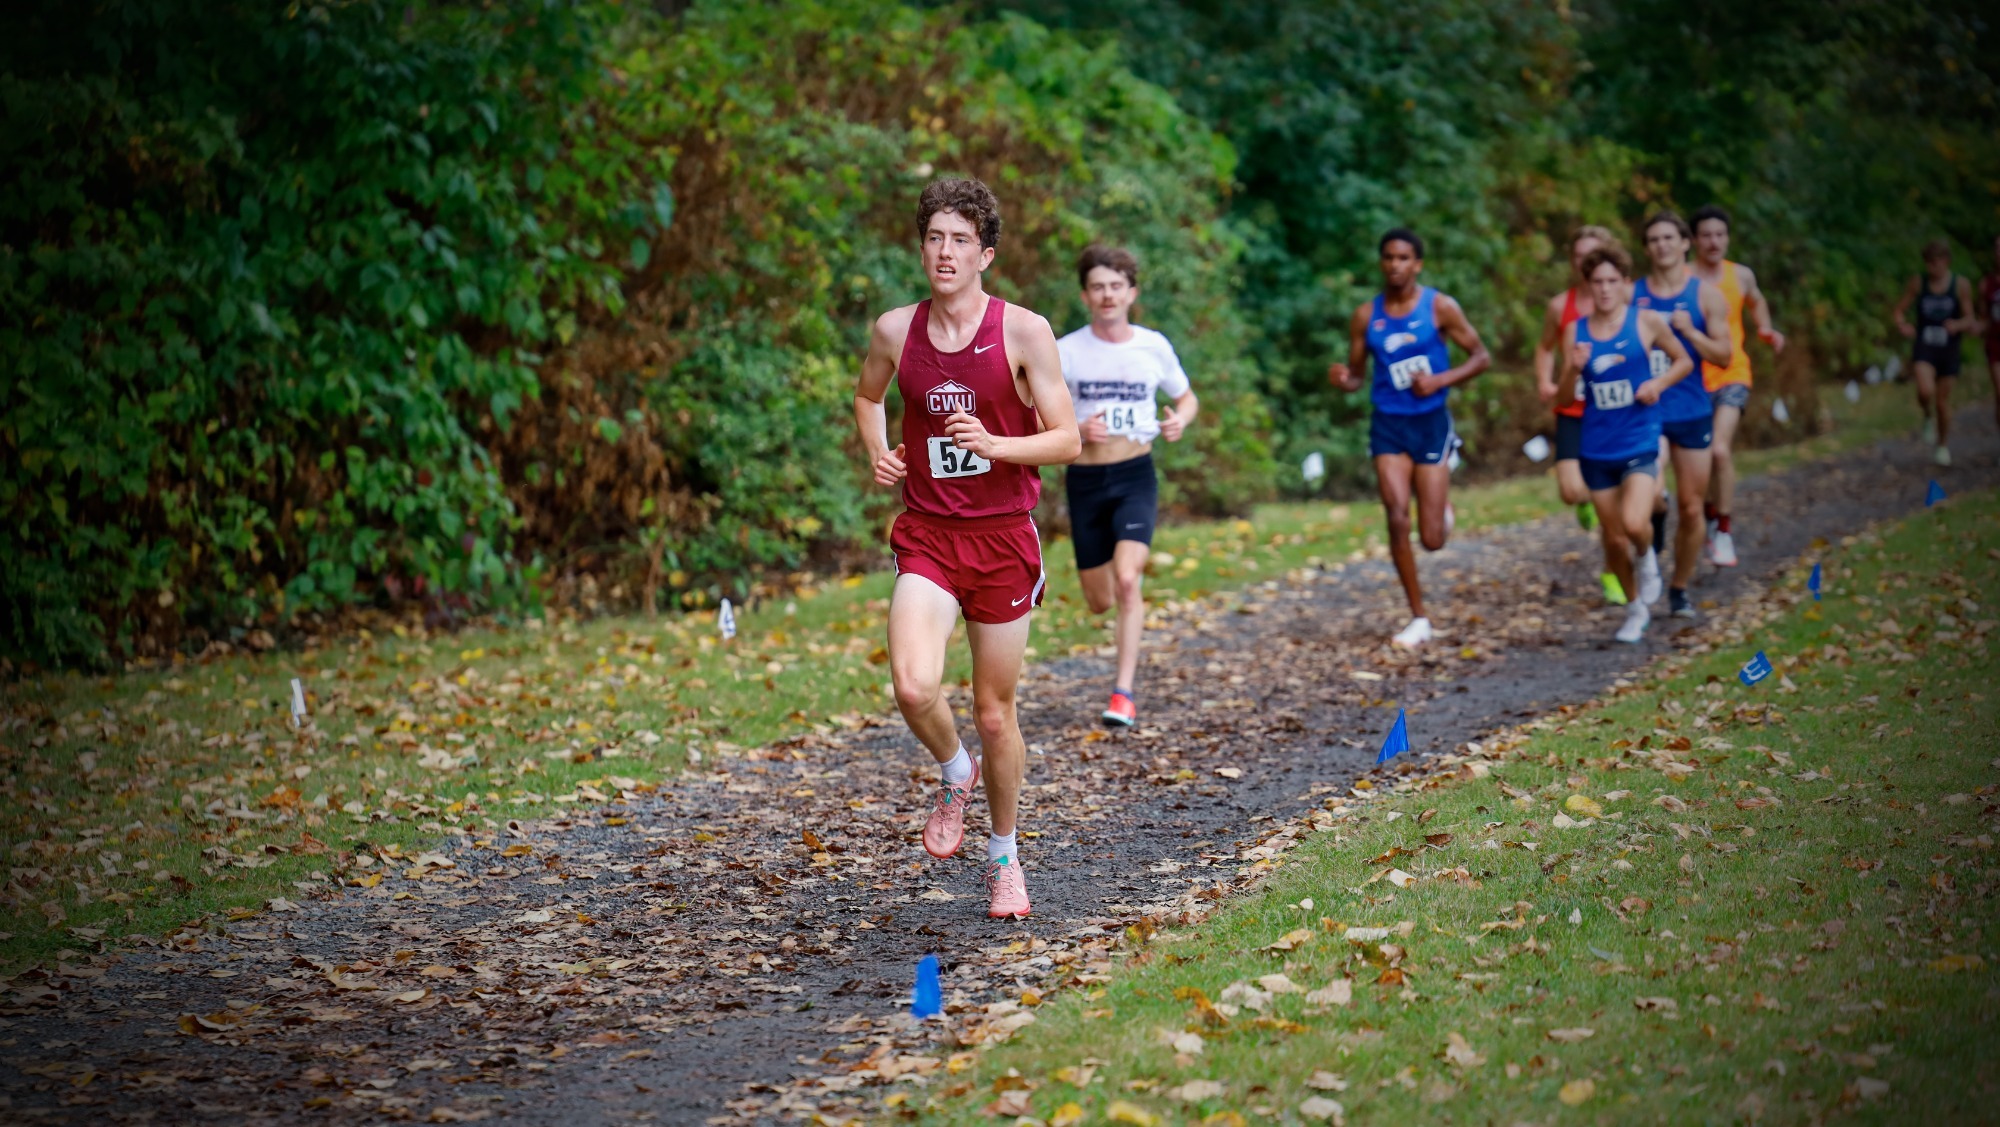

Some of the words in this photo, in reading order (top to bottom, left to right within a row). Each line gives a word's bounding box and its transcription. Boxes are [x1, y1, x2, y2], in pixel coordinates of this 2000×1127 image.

[929, 394, 972, 411] CWU
[1598, 381, 1627, 405] 147
[940, 441, 978, 474] 52
